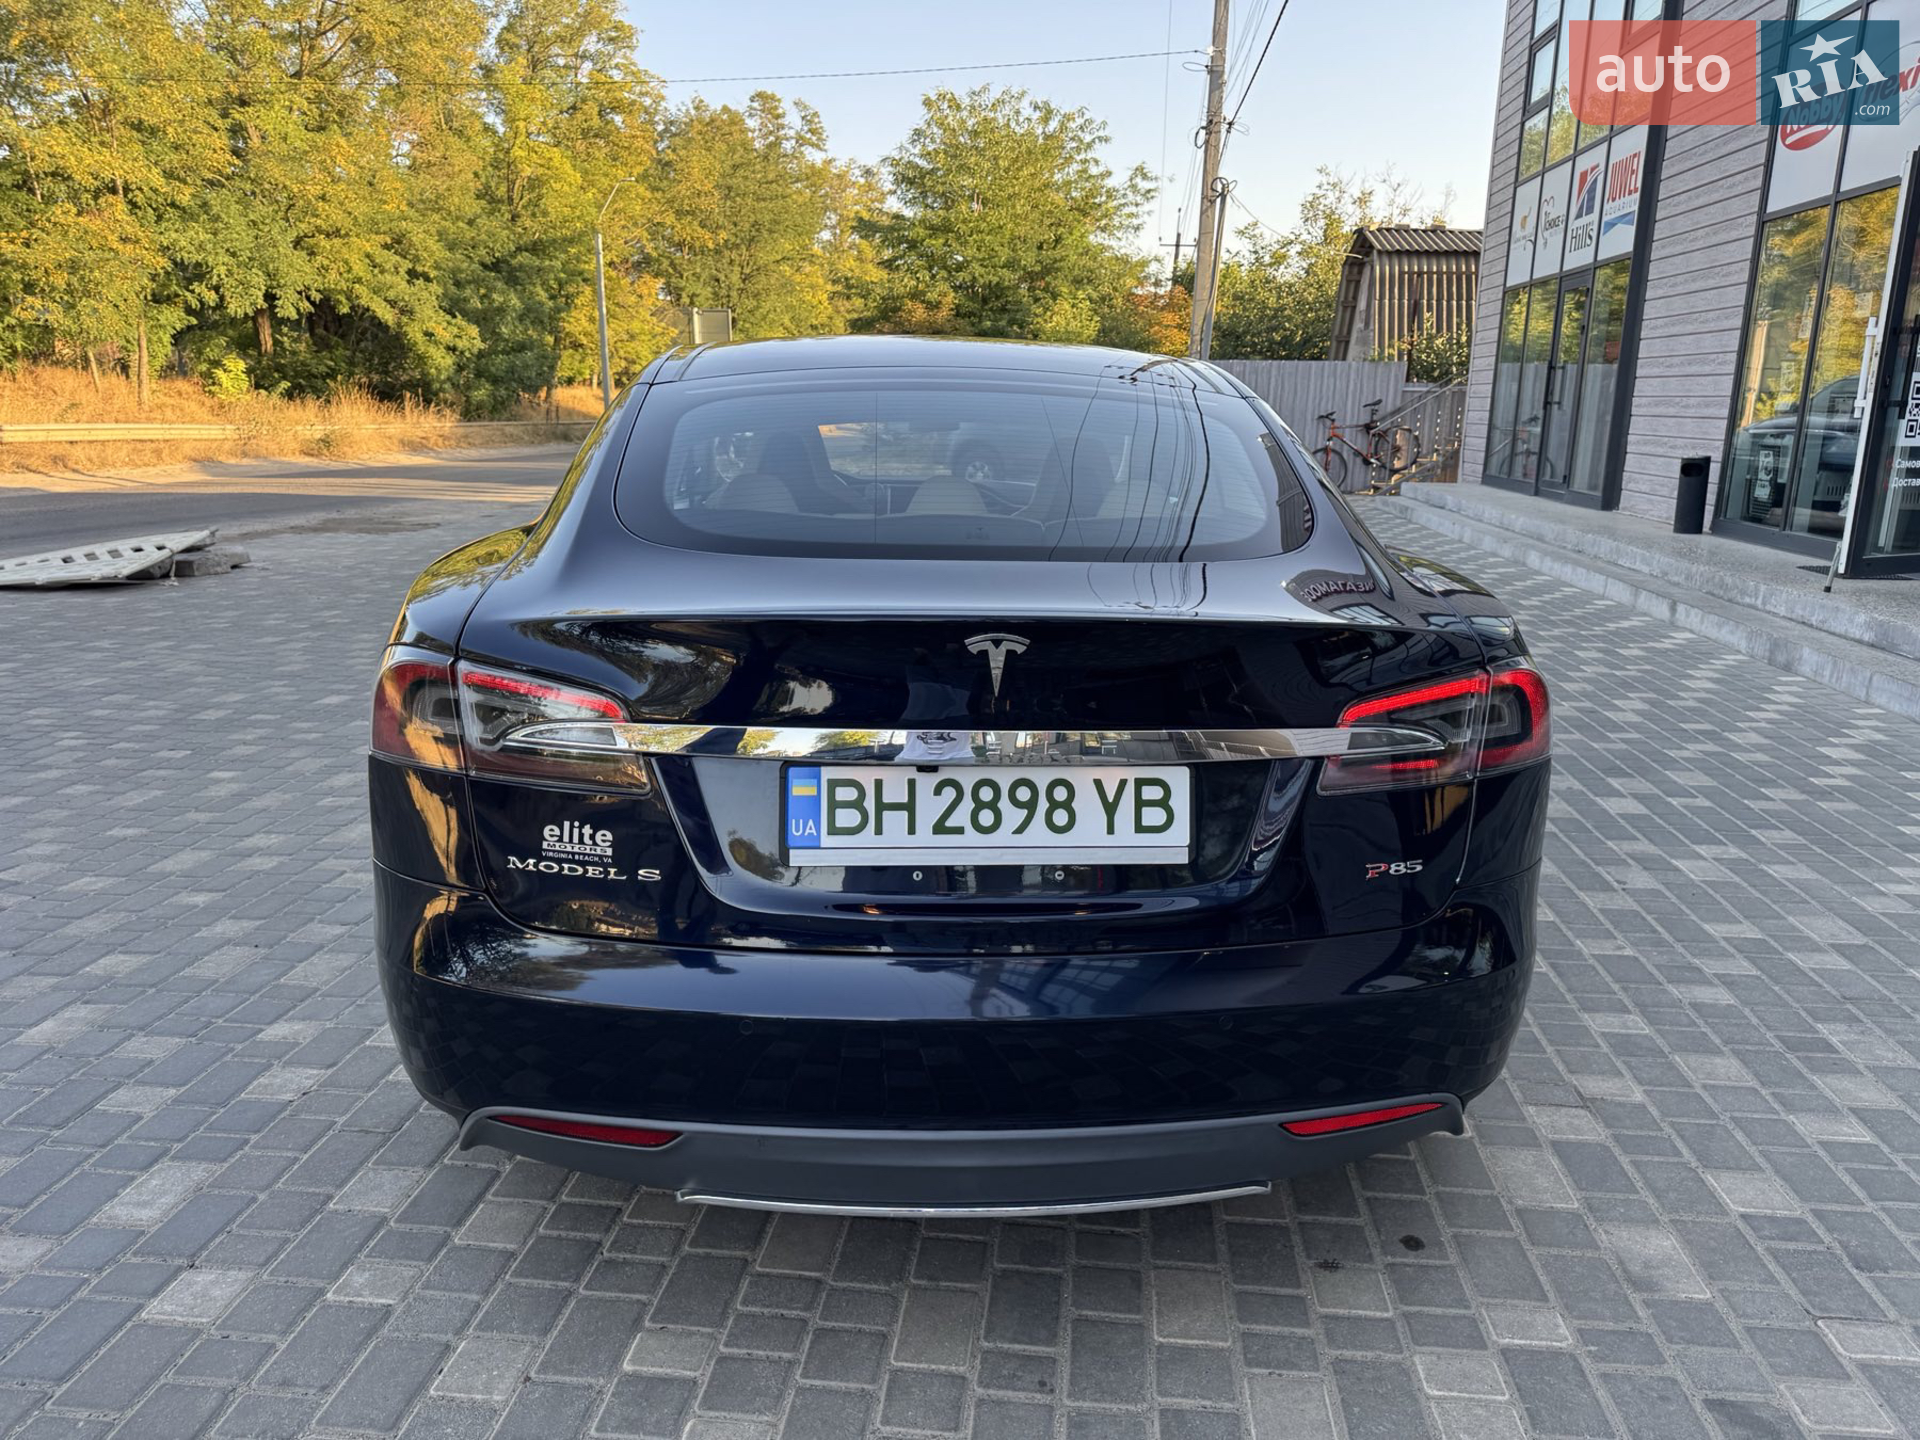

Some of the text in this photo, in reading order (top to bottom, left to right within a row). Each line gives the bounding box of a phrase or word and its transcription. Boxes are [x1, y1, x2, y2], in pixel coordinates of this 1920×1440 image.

[1607, 151, 1641, 204] JUWEL
[826, 777, 1175, 836] BH 2898 YB
[543, 820, 613, 847] elite
[791, 819, 817, 836] UA
[541, 851, 573, 859] VIRGINIA
[574, 854, 602, 863] BEACH,
[547, 843, 607, 853] MOTORS
[506, 856, 662, 881] MODEL S
[1365, 860, 1423, 880] P85
